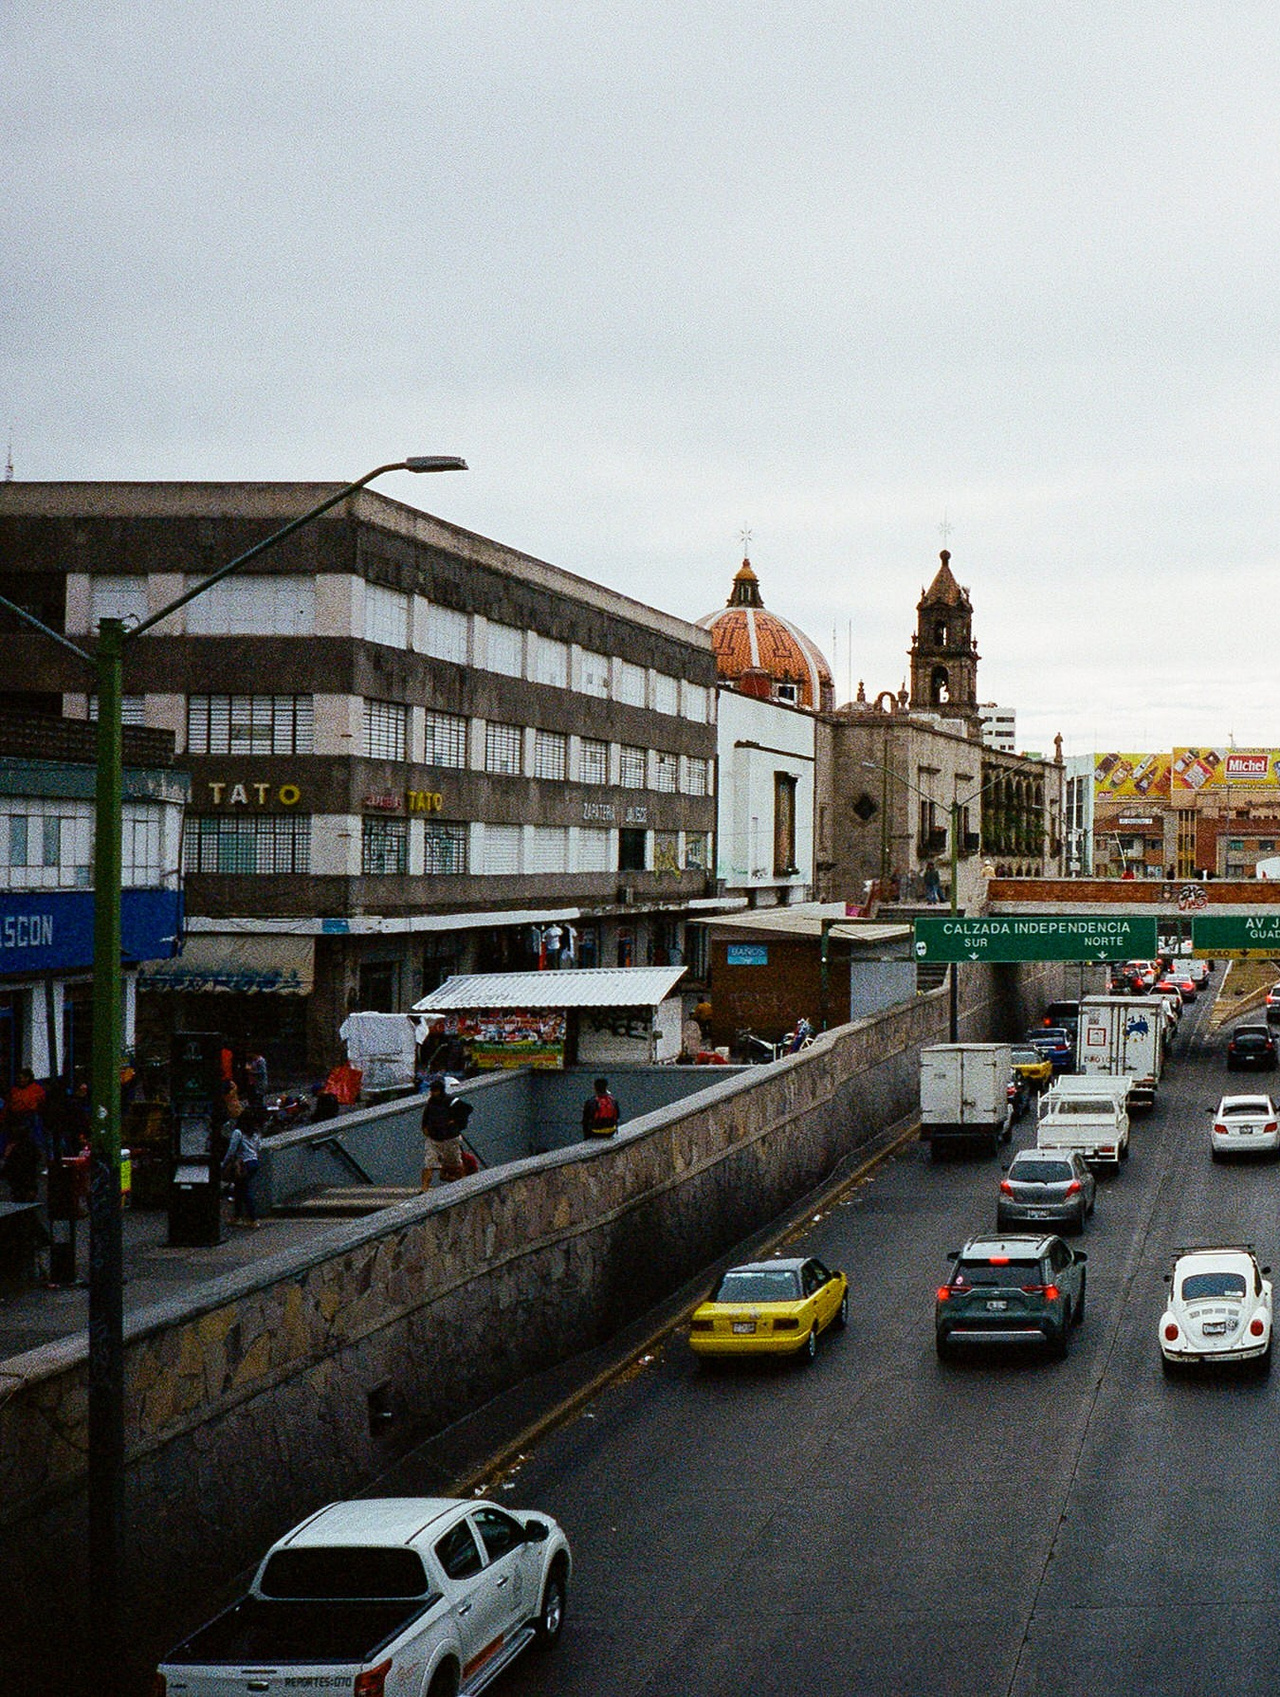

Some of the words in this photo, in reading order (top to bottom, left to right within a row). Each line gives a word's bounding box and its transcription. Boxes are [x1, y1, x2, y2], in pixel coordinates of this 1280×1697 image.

[1228, 758, 1267, 773] Michel
[208, 783, 301, 805] TATO
[408, 789, 444, 812] TATO
[943, 922, 1010, 935] CALZADA
[1014, 922, 1131, 935] INDEPENDENCIA
[1245, 917, 1264, 929] AV
[0, 915, 53, 948] SCON
[964, 938, 988, 948] SUR
[1084, 937, 1124, 947] NORTE
